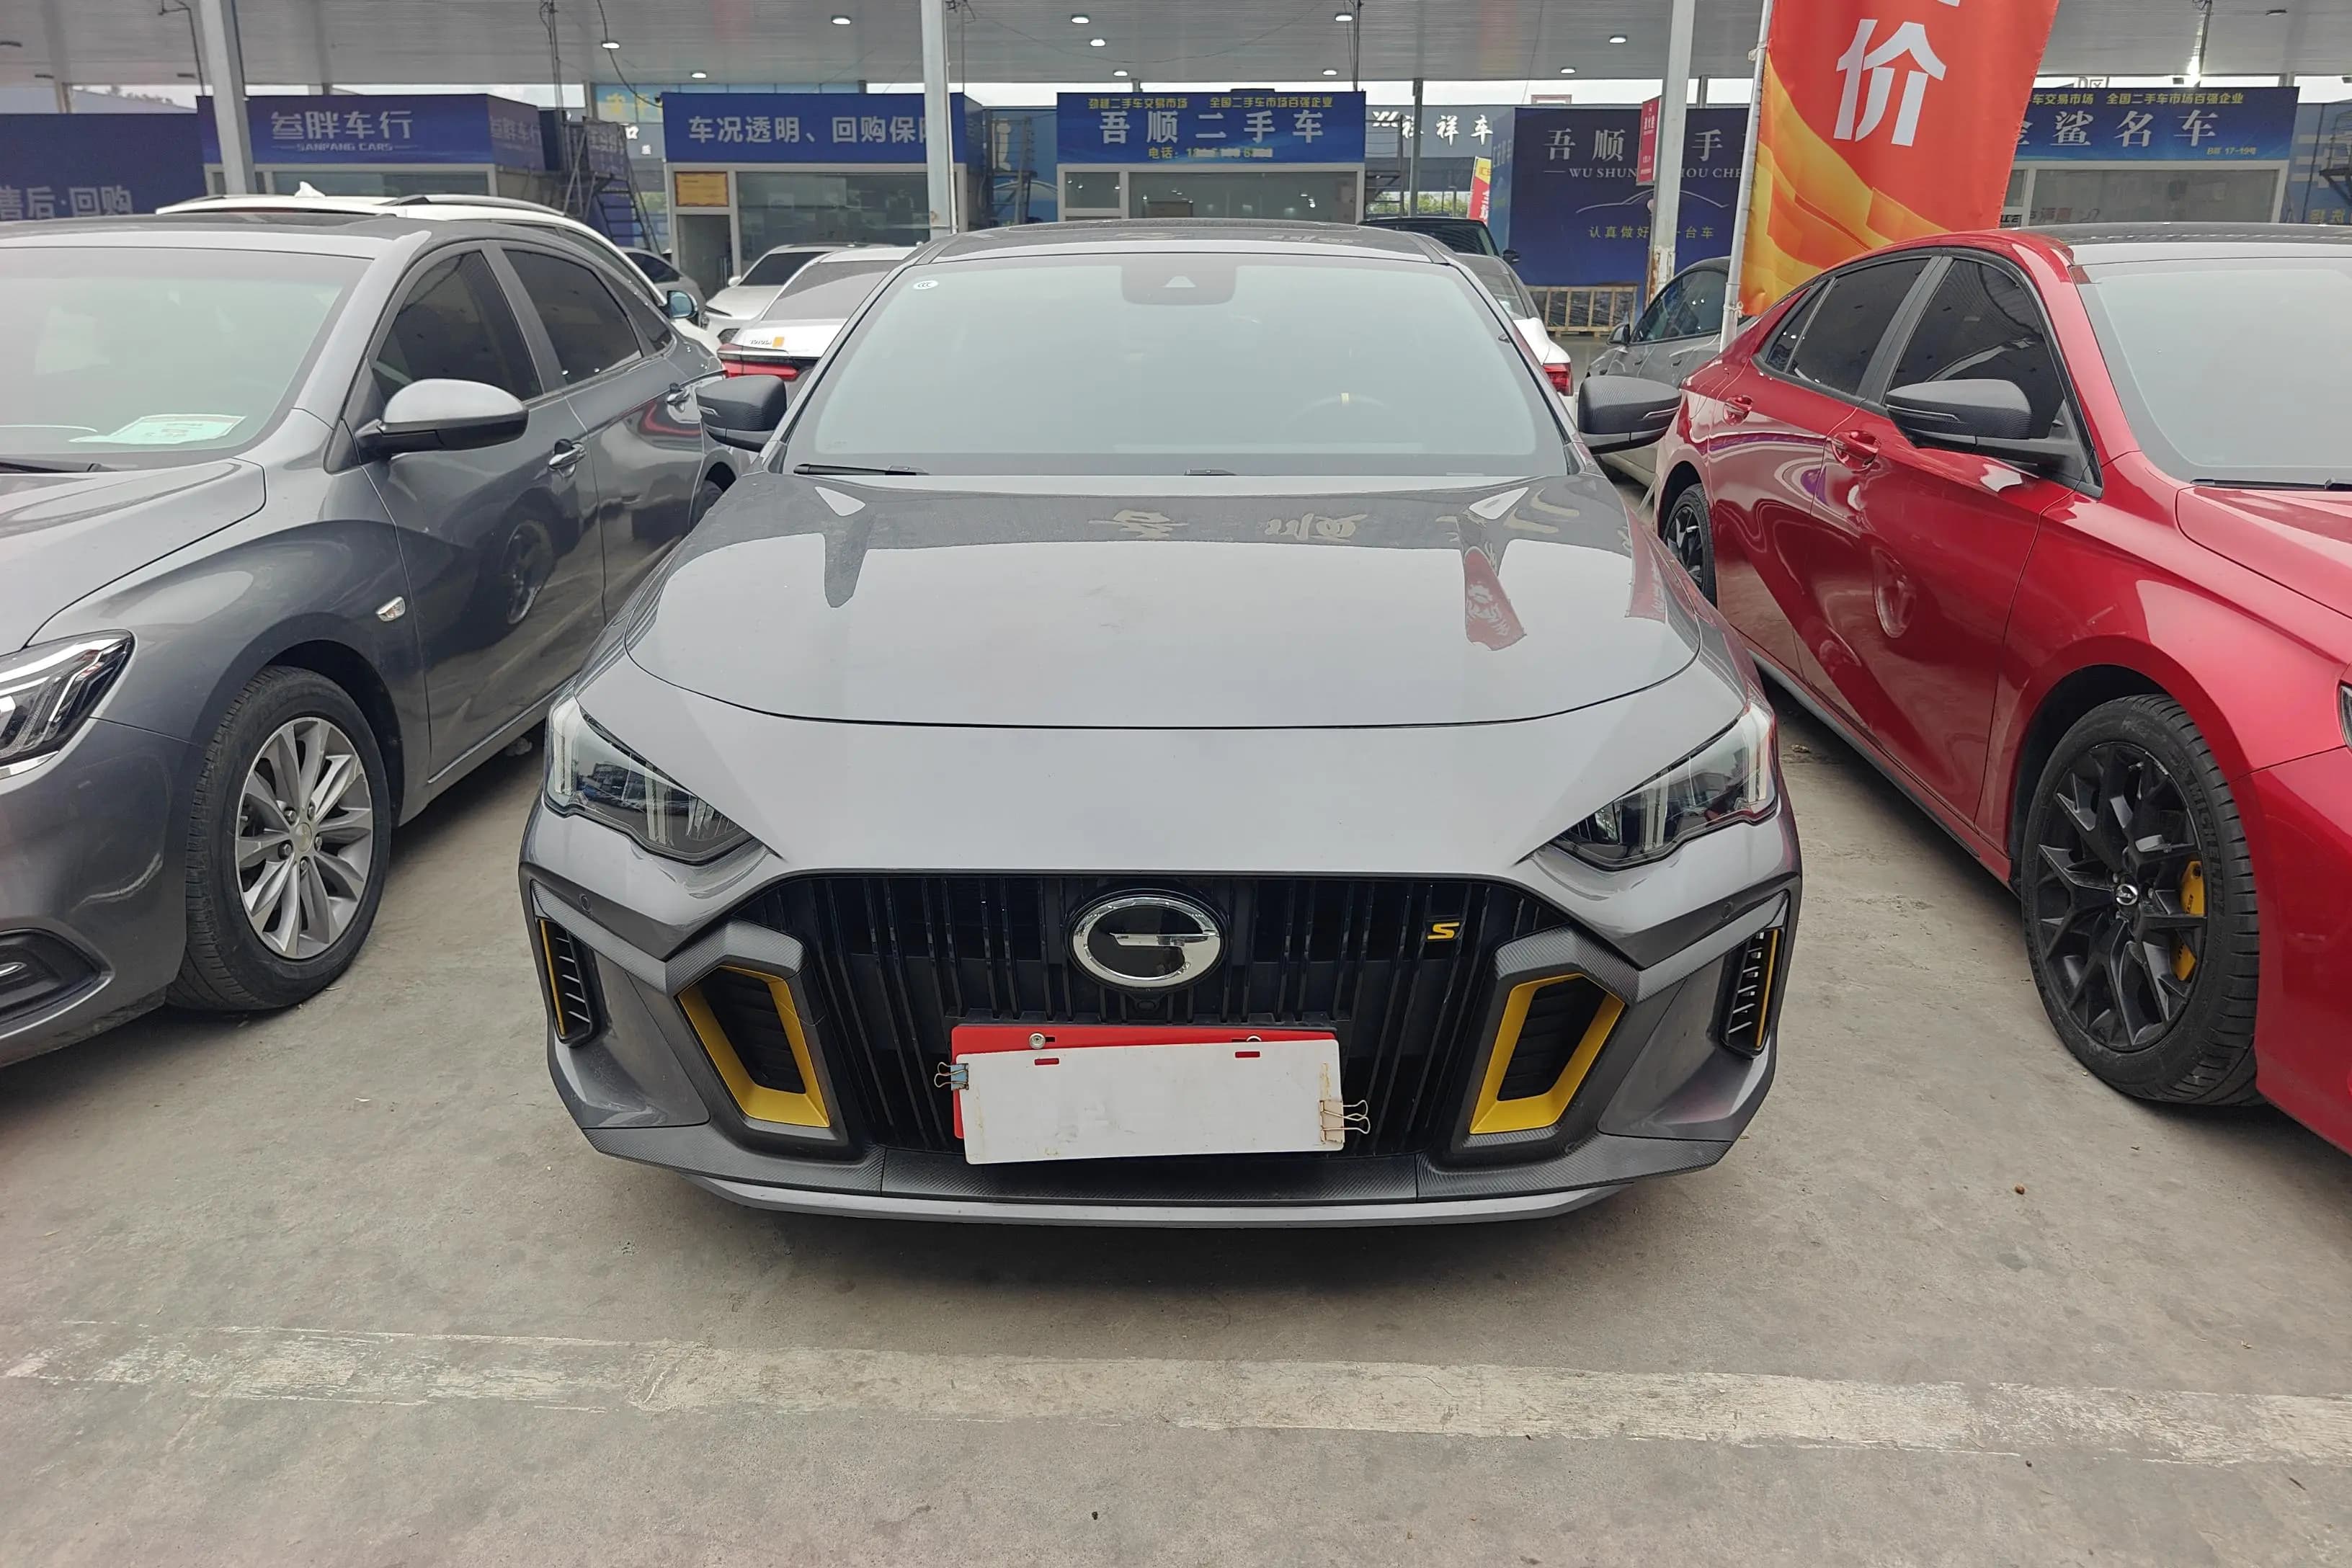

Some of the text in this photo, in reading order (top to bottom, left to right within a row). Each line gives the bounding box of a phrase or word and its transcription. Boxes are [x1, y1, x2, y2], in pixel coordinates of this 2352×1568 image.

[1833, 19, 1946, 146] 价
[1210, 97, 1332, 108] 全国二手车市场百强企业
[2028, 92, 2244, 105] 车交易市场 全国二手车市场百强企业
[1100, 110, 1324, 144] 吾顺二手车
[360, 143, 393, 151] CARS
[1569, 167, 1592, 178] WU
[1597, 167, 1638, 179] SHUN
[1682, 167, 1709, 178] OU
[1589, 226, 1714, 239] 认真做好台车
[1427, 922, 1460, 940] S
